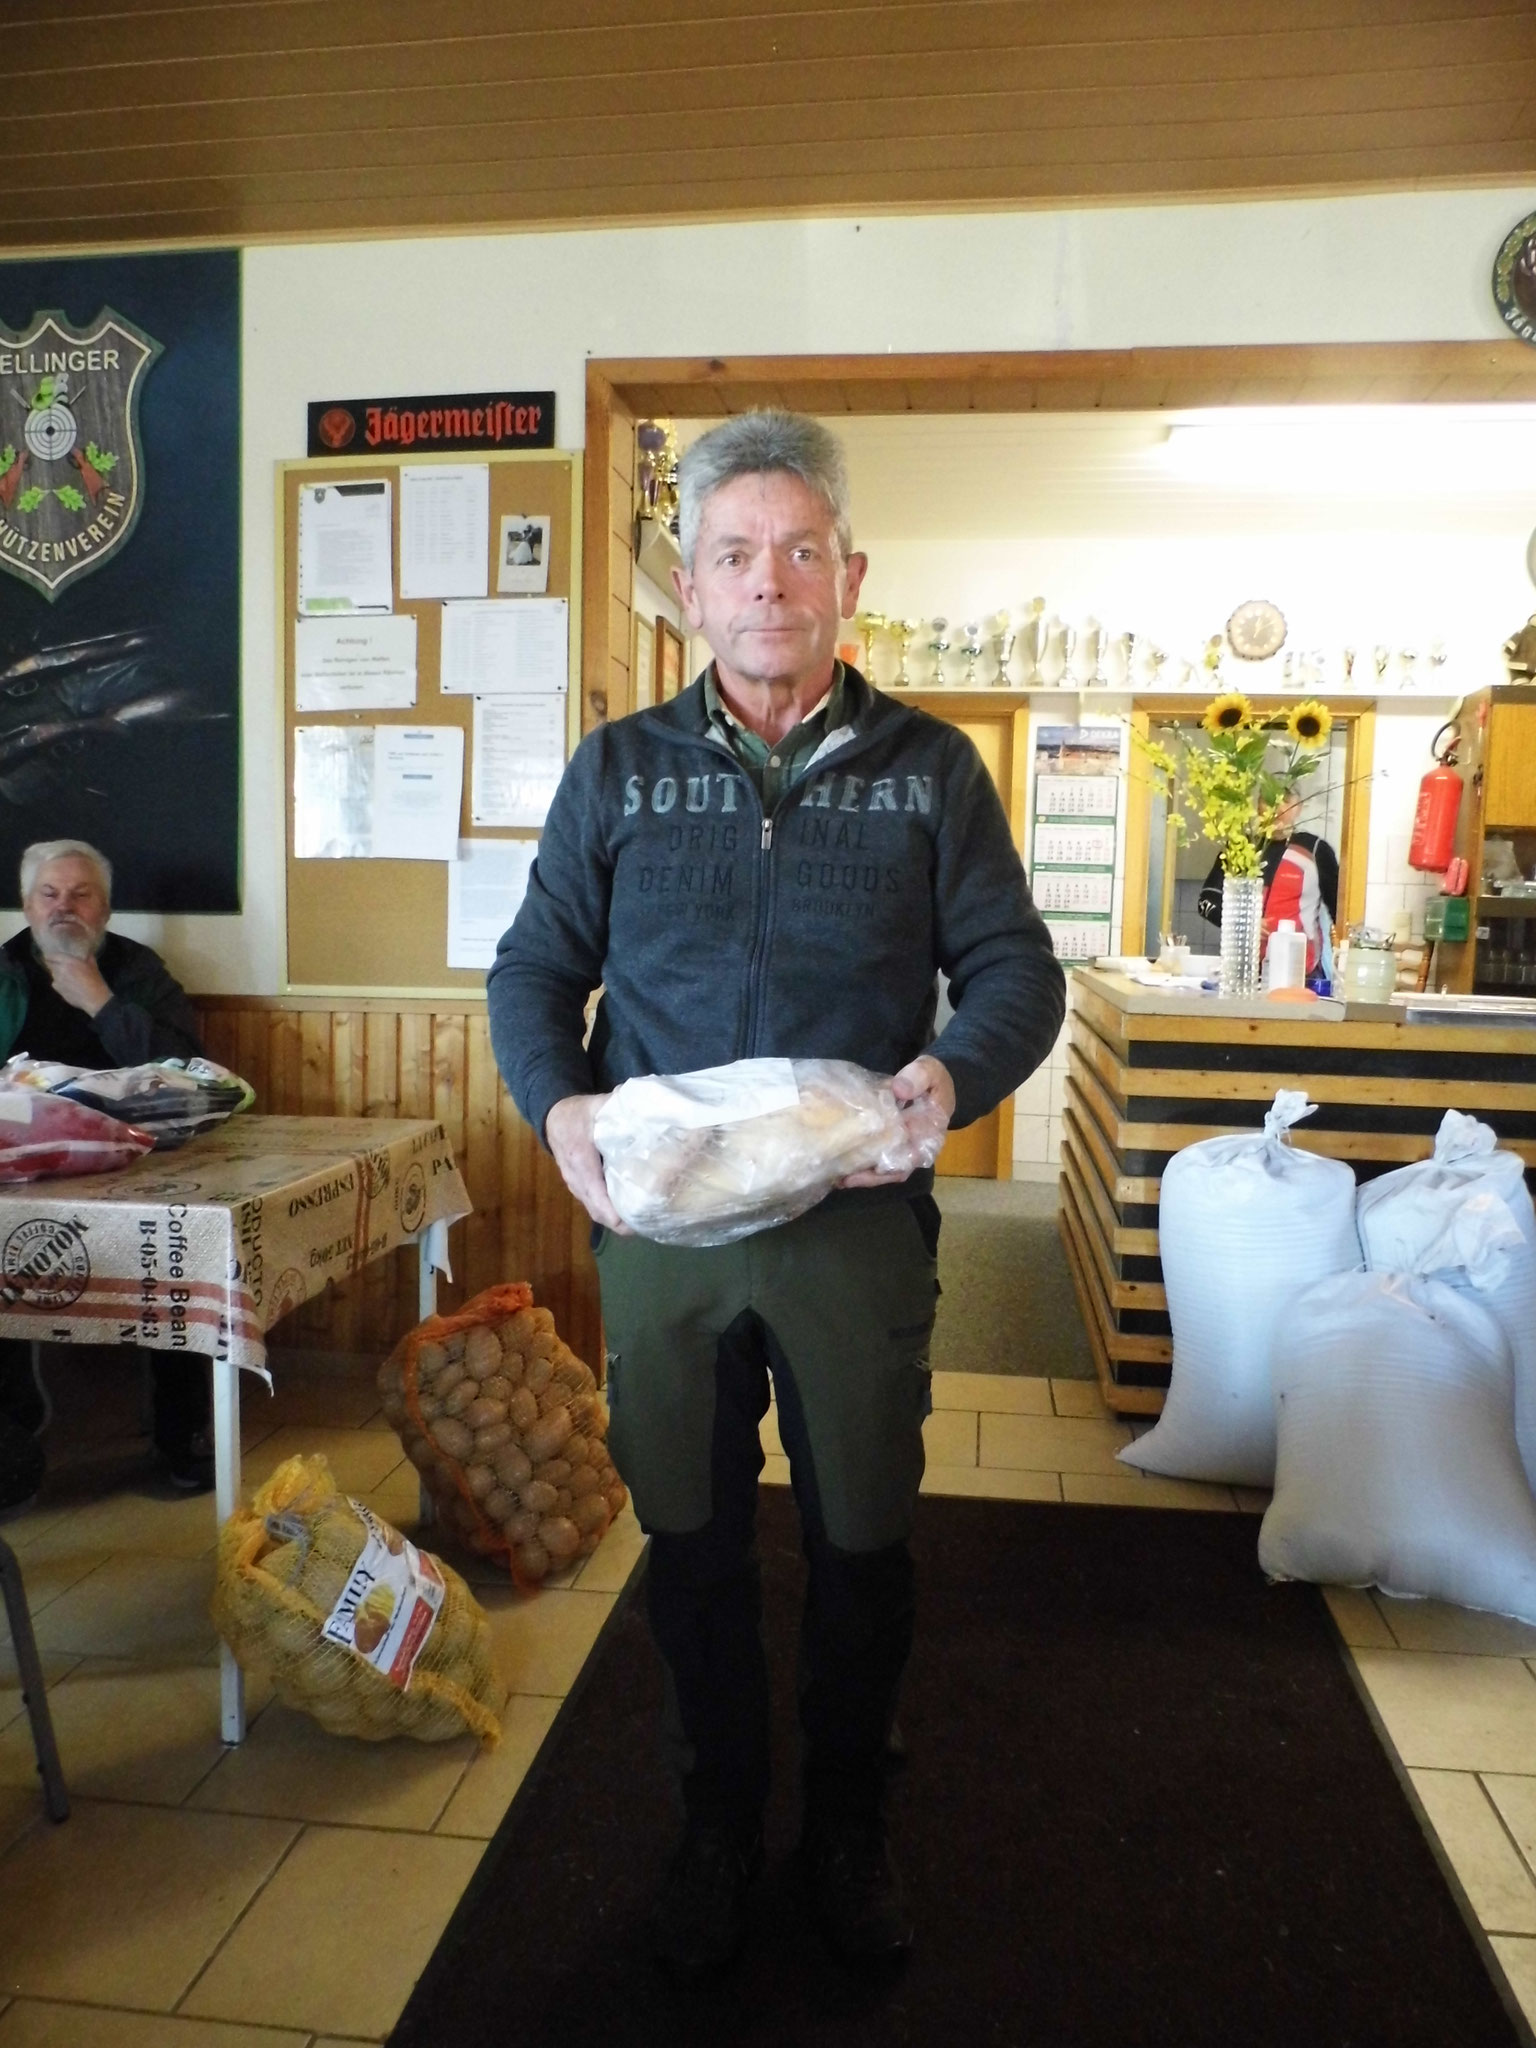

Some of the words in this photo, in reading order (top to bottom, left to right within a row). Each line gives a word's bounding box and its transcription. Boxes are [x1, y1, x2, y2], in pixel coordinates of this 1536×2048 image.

[0, 349, 120, 375] ELLINGER
[167, 1204, 189, 1278] Coffee
[170, 1288, 190, 1347] Bean
